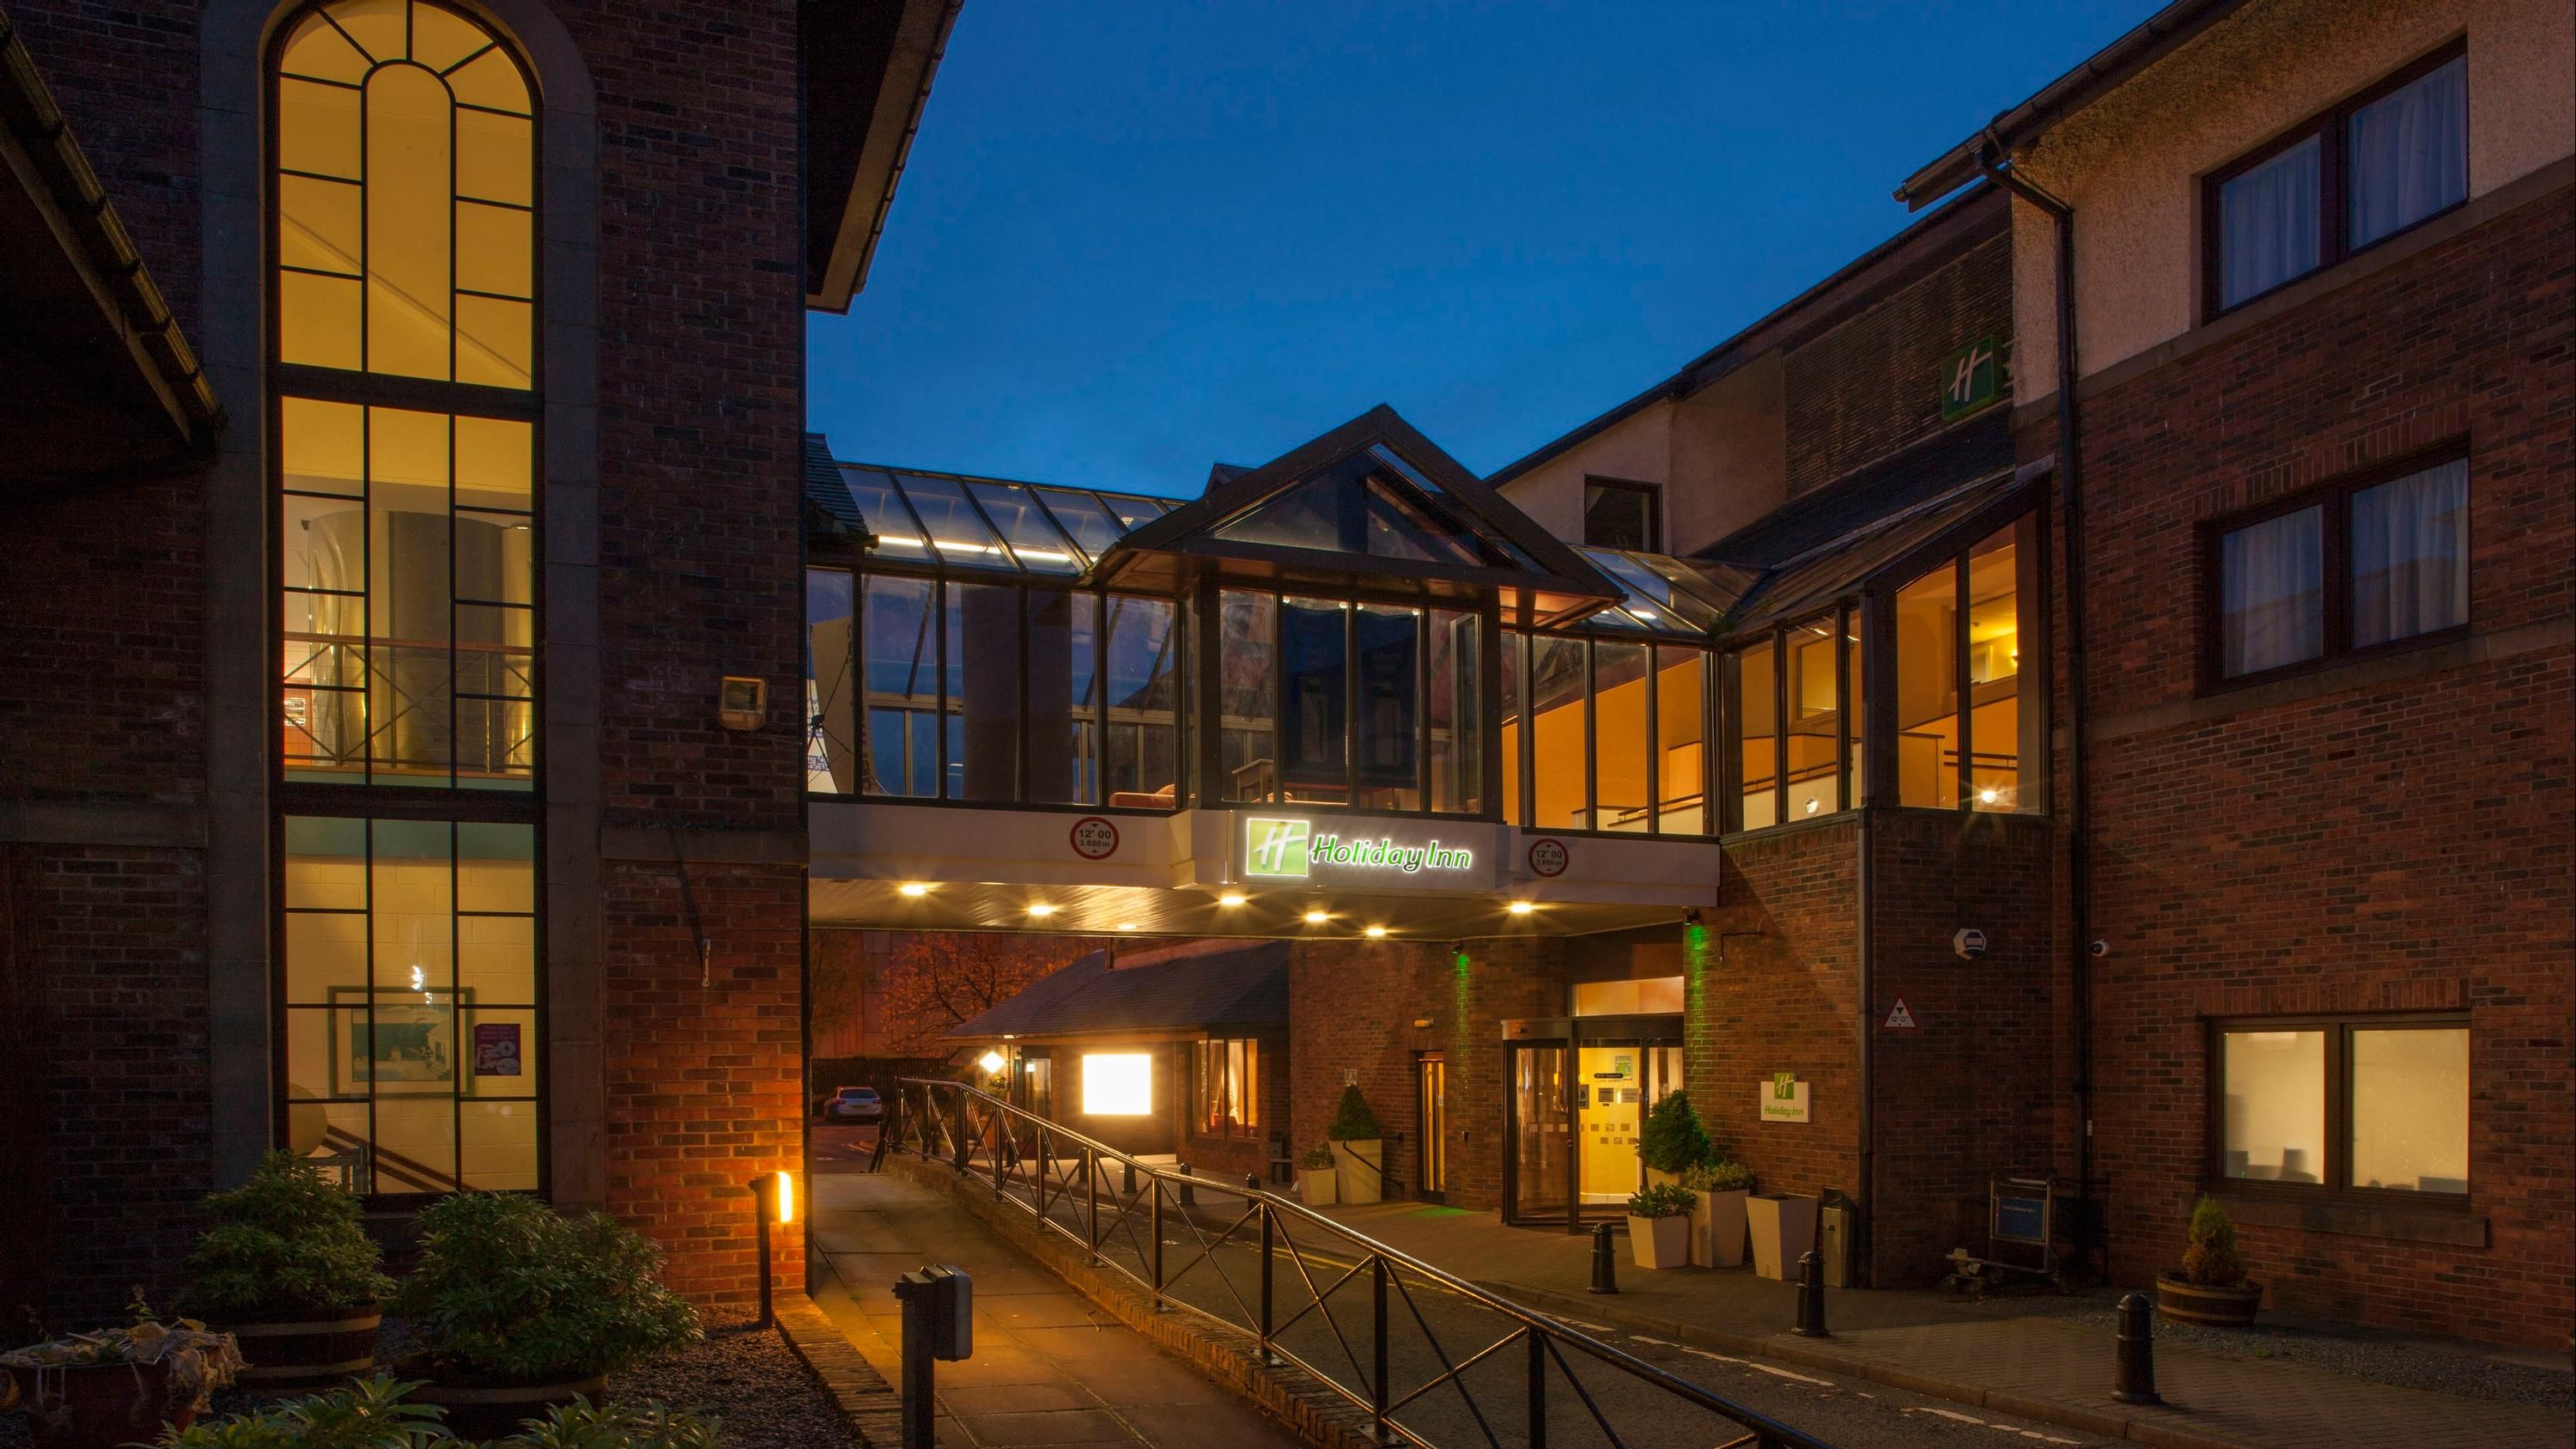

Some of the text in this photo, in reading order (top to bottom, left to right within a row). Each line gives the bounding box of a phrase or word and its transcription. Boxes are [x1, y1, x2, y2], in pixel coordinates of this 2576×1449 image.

[1309, 833, 1473, 873] Holiday Inn
[1765, 1105, 1804, 1117] Holiday Inn
